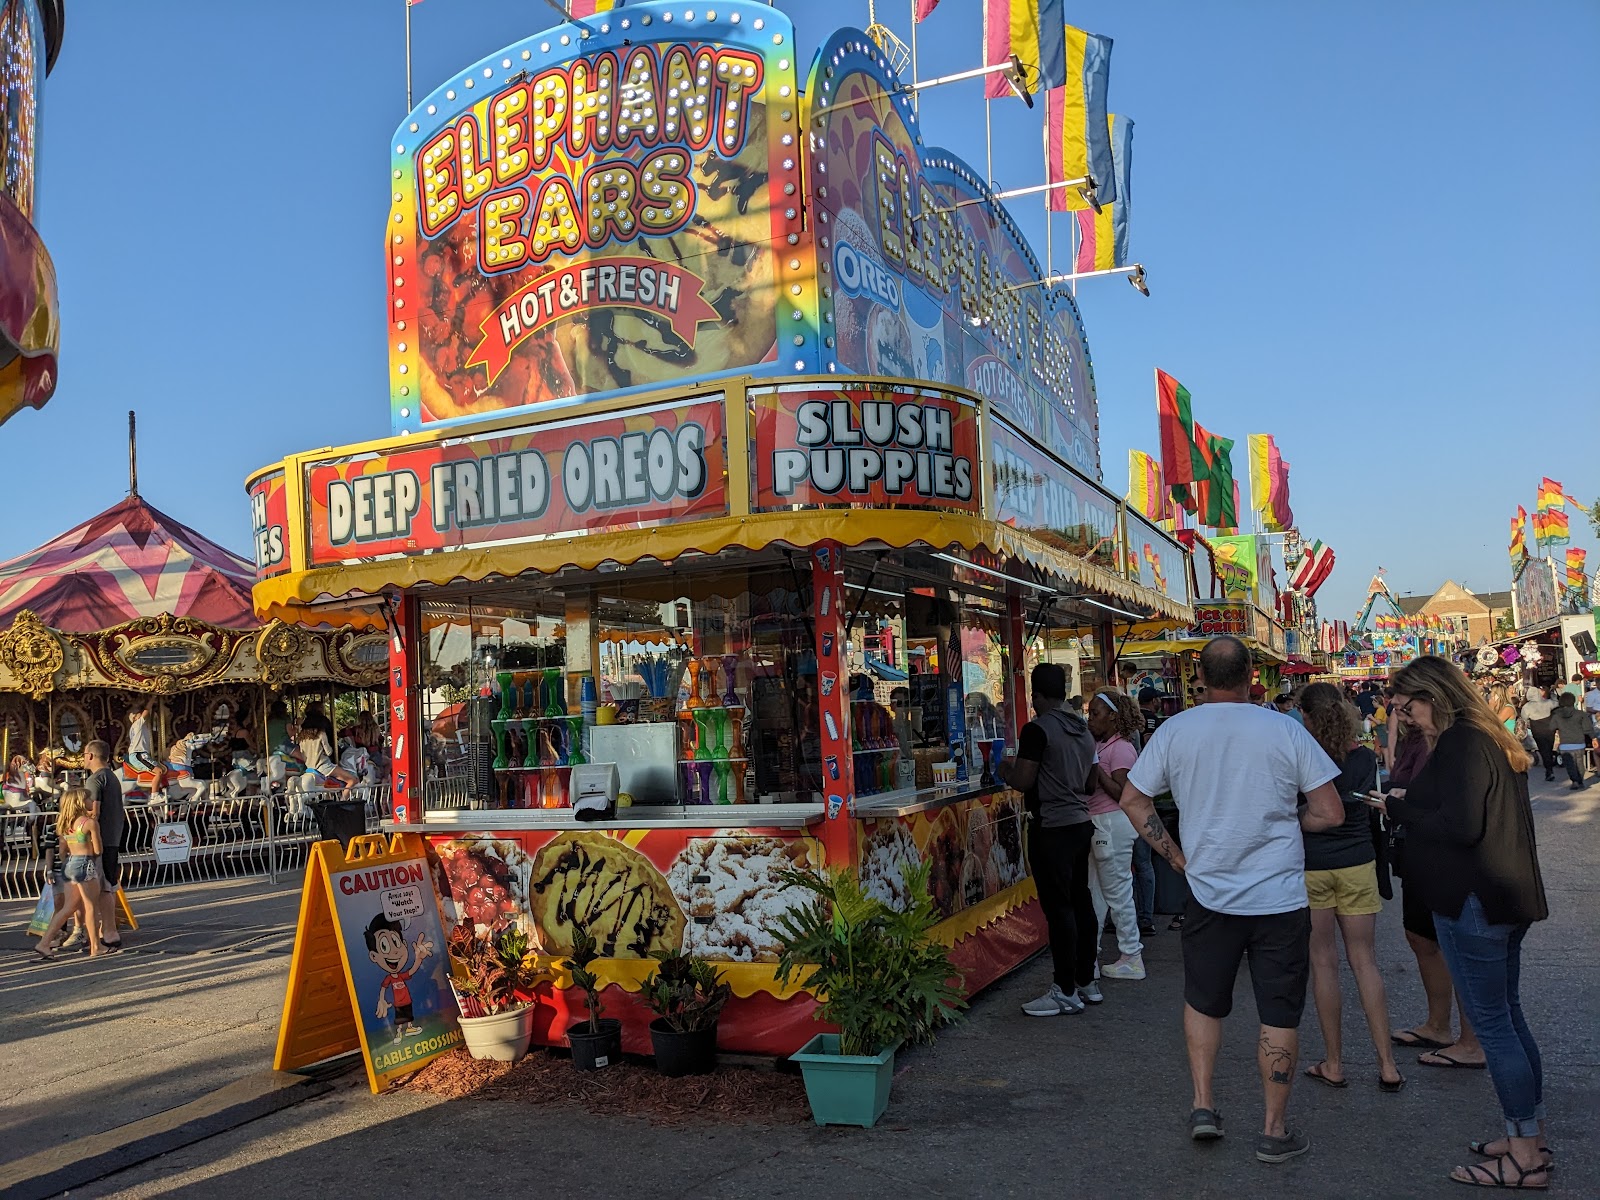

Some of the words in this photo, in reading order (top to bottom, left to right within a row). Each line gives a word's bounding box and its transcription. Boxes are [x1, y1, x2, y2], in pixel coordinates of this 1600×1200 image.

[418, 43, 765, 238] ELEPHANT
[479, 148, 695, 274] EARS
[837, 244, 900, 311] OREO
[796, 400, 955, 454] SLUSH
[327, 469, 421, 545] DEEP
[431, 448, 550, 532] FRIED
[563, 422, 707, 514] OREOS
[773, 448, 973, 502] PUPPIES
[1196, 609, 1221, 621] ICE
[340, 863, 424, 896] CAUTION
[375, 1042, 413, 1070] CABLE
